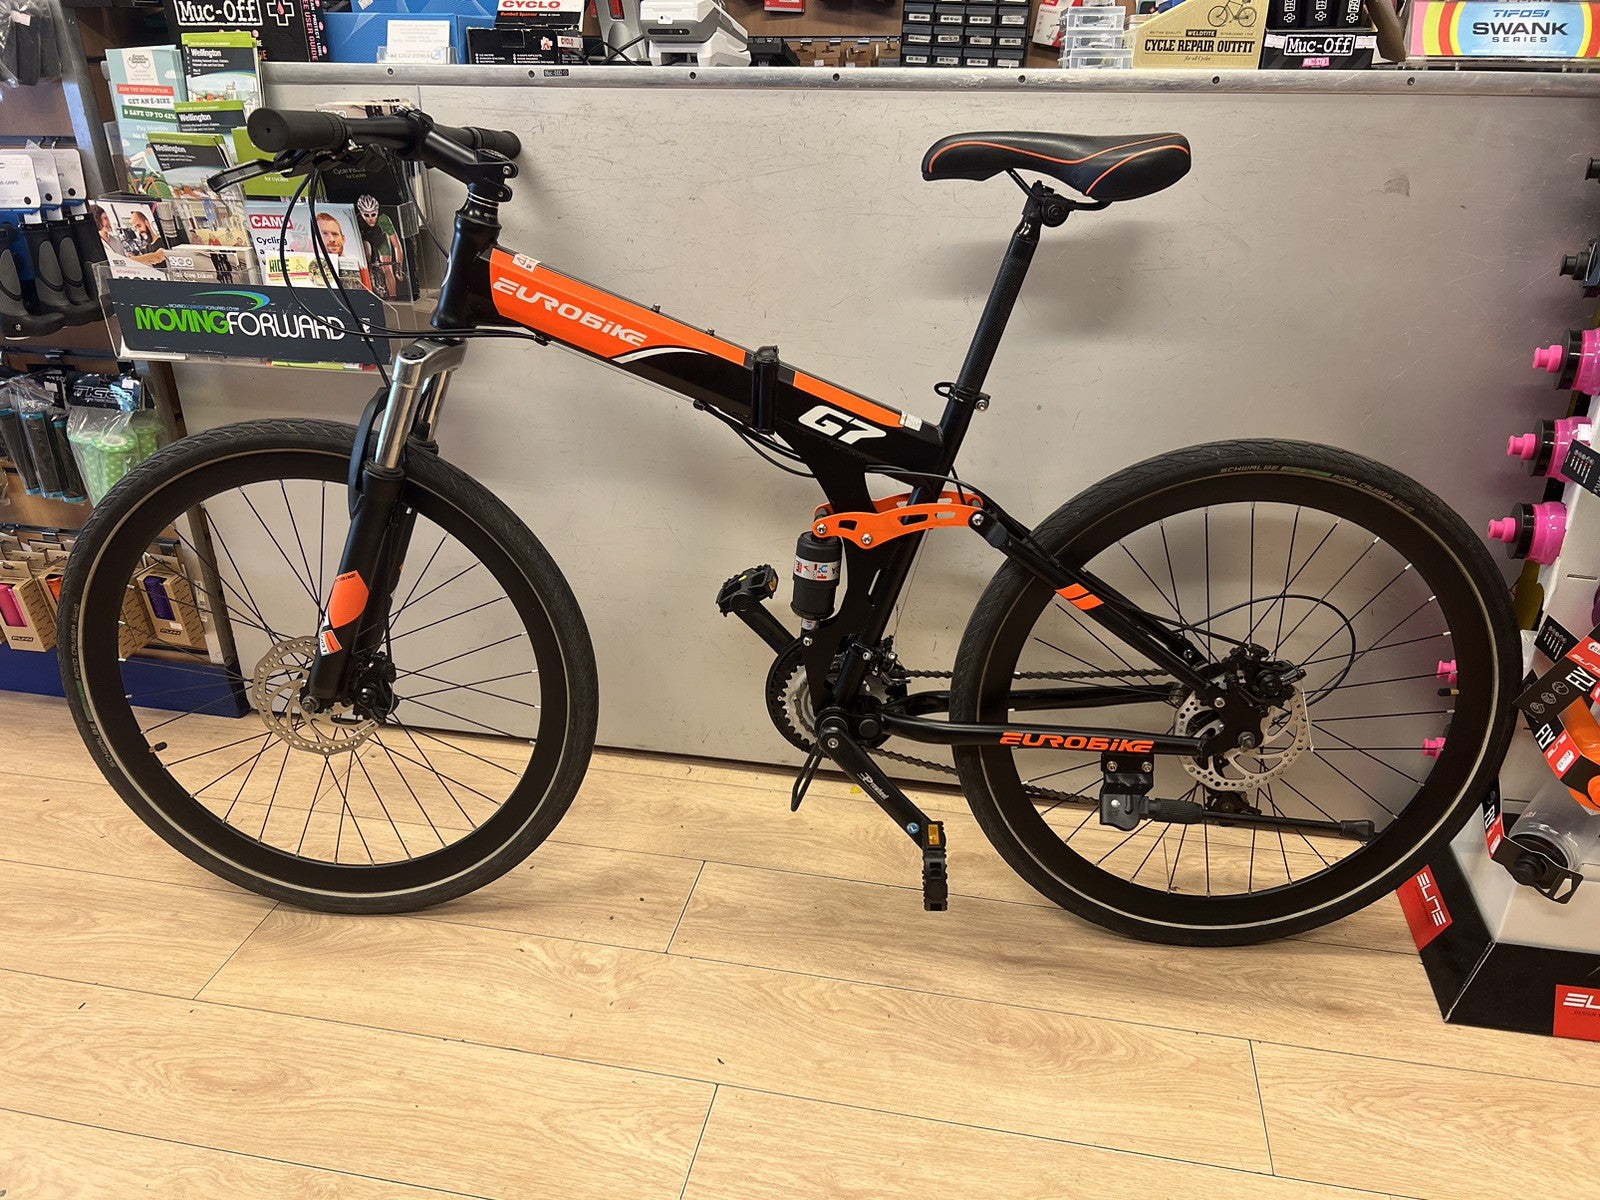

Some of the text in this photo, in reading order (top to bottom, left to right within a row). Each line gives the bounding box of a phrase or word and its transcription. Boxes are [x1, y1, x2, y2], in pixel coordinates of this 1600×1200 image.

[181, 0, 258, 21] Muc-Off
[502, 0, 560, 9] CYCLO
[1493, 9, 1549, 18] TIFOSI
[304, 12, 314, 33] USER
[1472, 22, 1569, 36] SWANK
[1144, 39, 1255, 53] CYCLE REPAIR OUTFIT
[1287, 37, 1352, 53] Muc-Off
[190, 49, 222, 58] Wellington
[178, 113, 212, 122] Wellington
[153, 144, 187, 154] Wellington
[798, 404, 887, 445] G7
[1565, 666, 1597, 692] FLY
[1535, 723, 1556, 750] FLY
[1484, 804, 1496, 830] FLY
